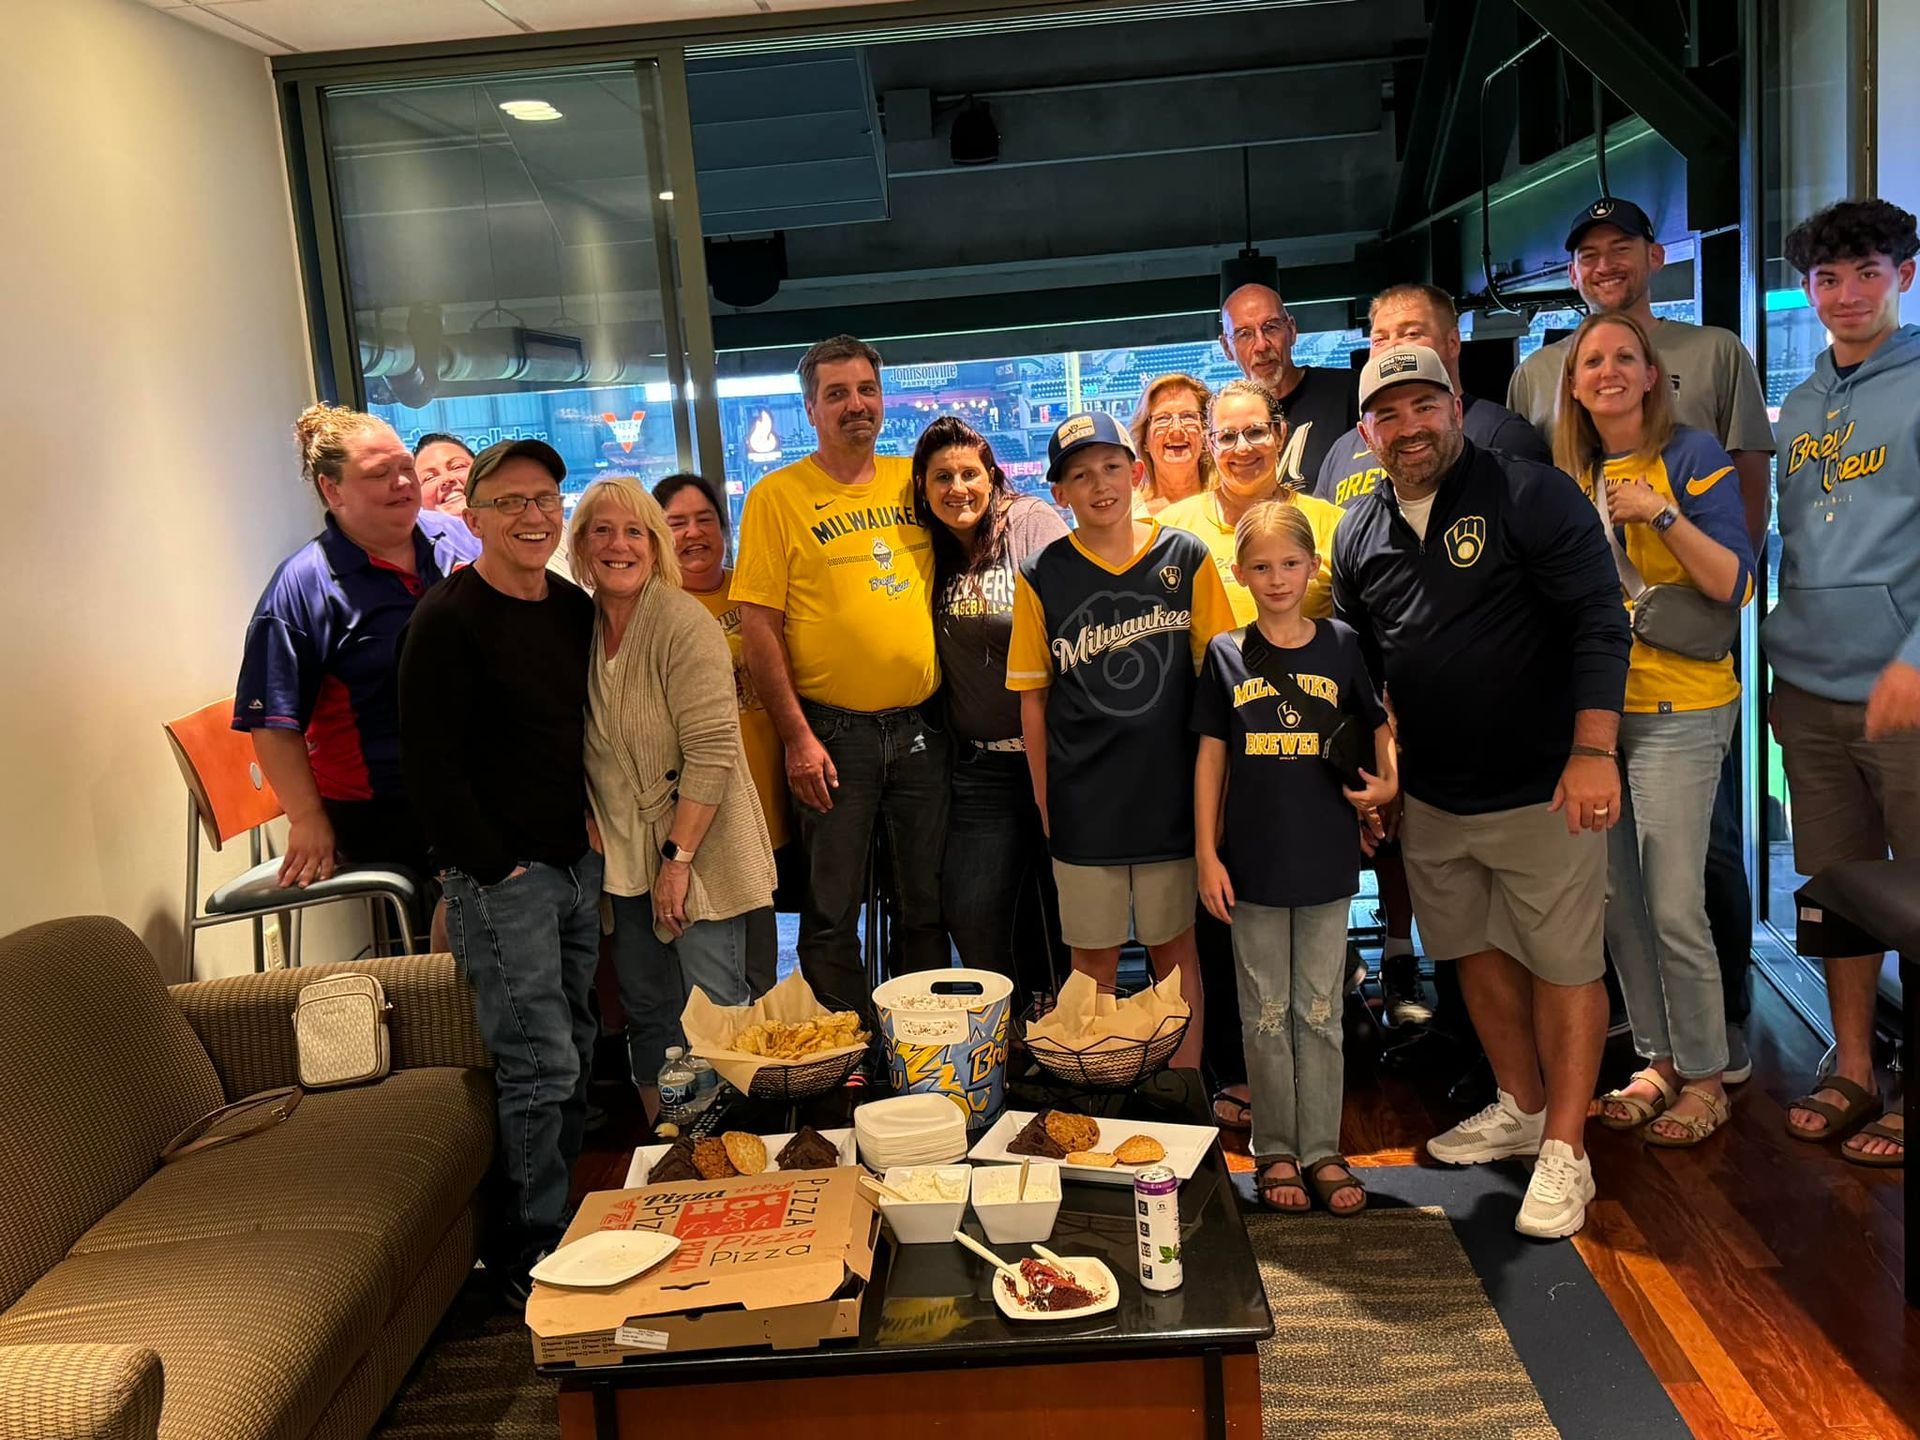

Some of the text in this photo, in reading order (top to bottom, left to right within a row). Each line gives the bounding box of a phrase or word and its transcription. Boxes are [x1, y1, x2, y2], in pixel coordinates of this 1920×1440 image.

[889, 364, 958, 383] Johnsonville
[1052, 603, 1191, 675] Milwaukee
[1245, 732, 1320, 755] BREWER
[642, 1190, 727, 1207] Pizza
[691, 1193, 783, 1216] Hot
[783, 1178, 830, 1228] PIZZA
[681, 1212, 771, 1239] Fresh
[721, 1209, 748, 1223] &
[713, 1229, 817, 1252] Pizza
[709, 1244, 811, 1267] Pizza
